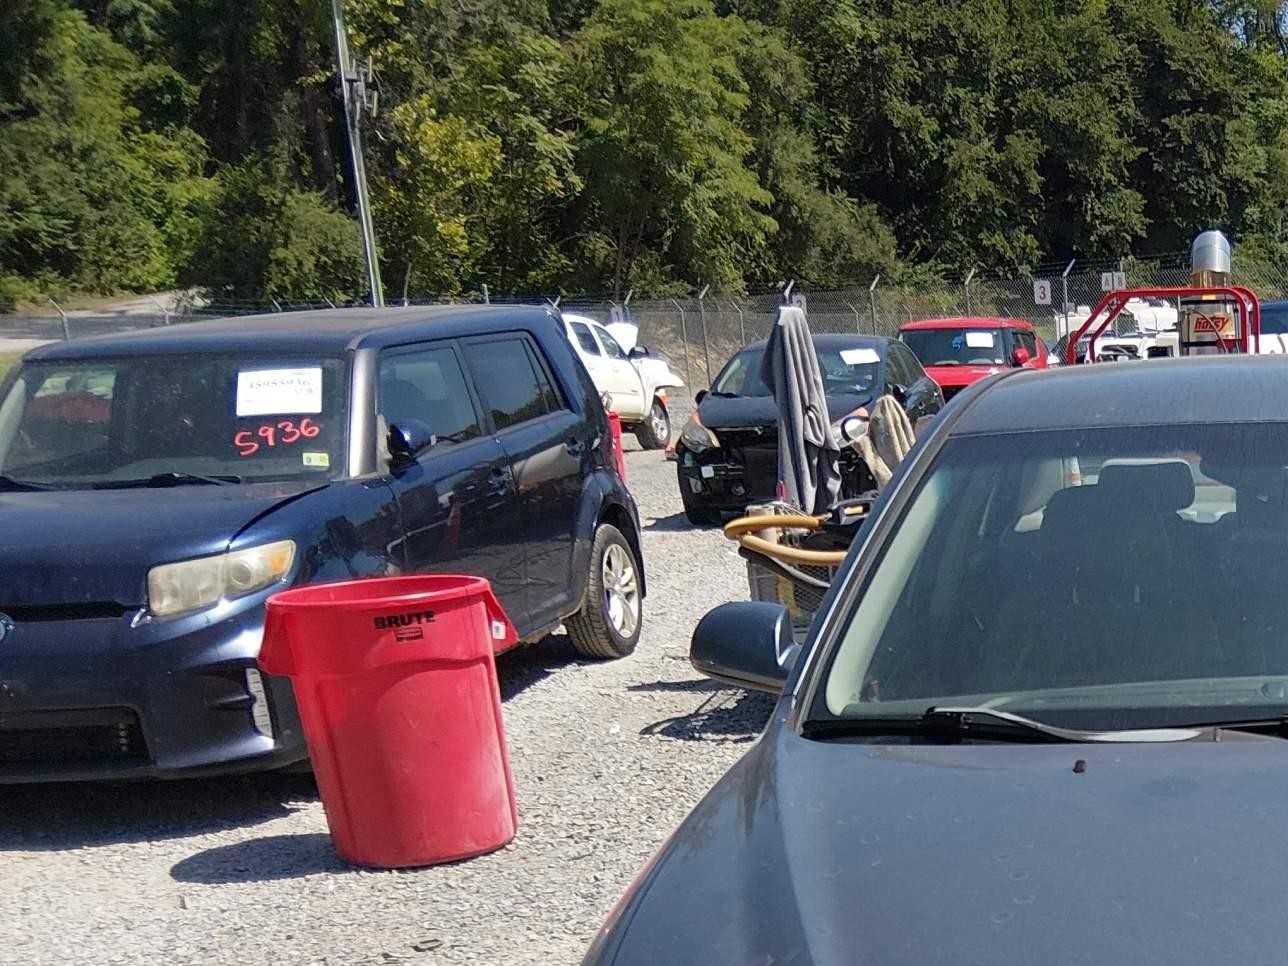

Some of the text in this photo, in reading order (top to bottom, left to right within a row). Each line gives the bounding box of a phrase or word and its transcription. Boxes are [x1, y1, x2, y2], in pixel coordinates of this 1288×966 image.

[1039, 285, 1047, 300] 3
[234, 418, 320, 456] 5936
[373, 610, 436, 630] BRUTE
